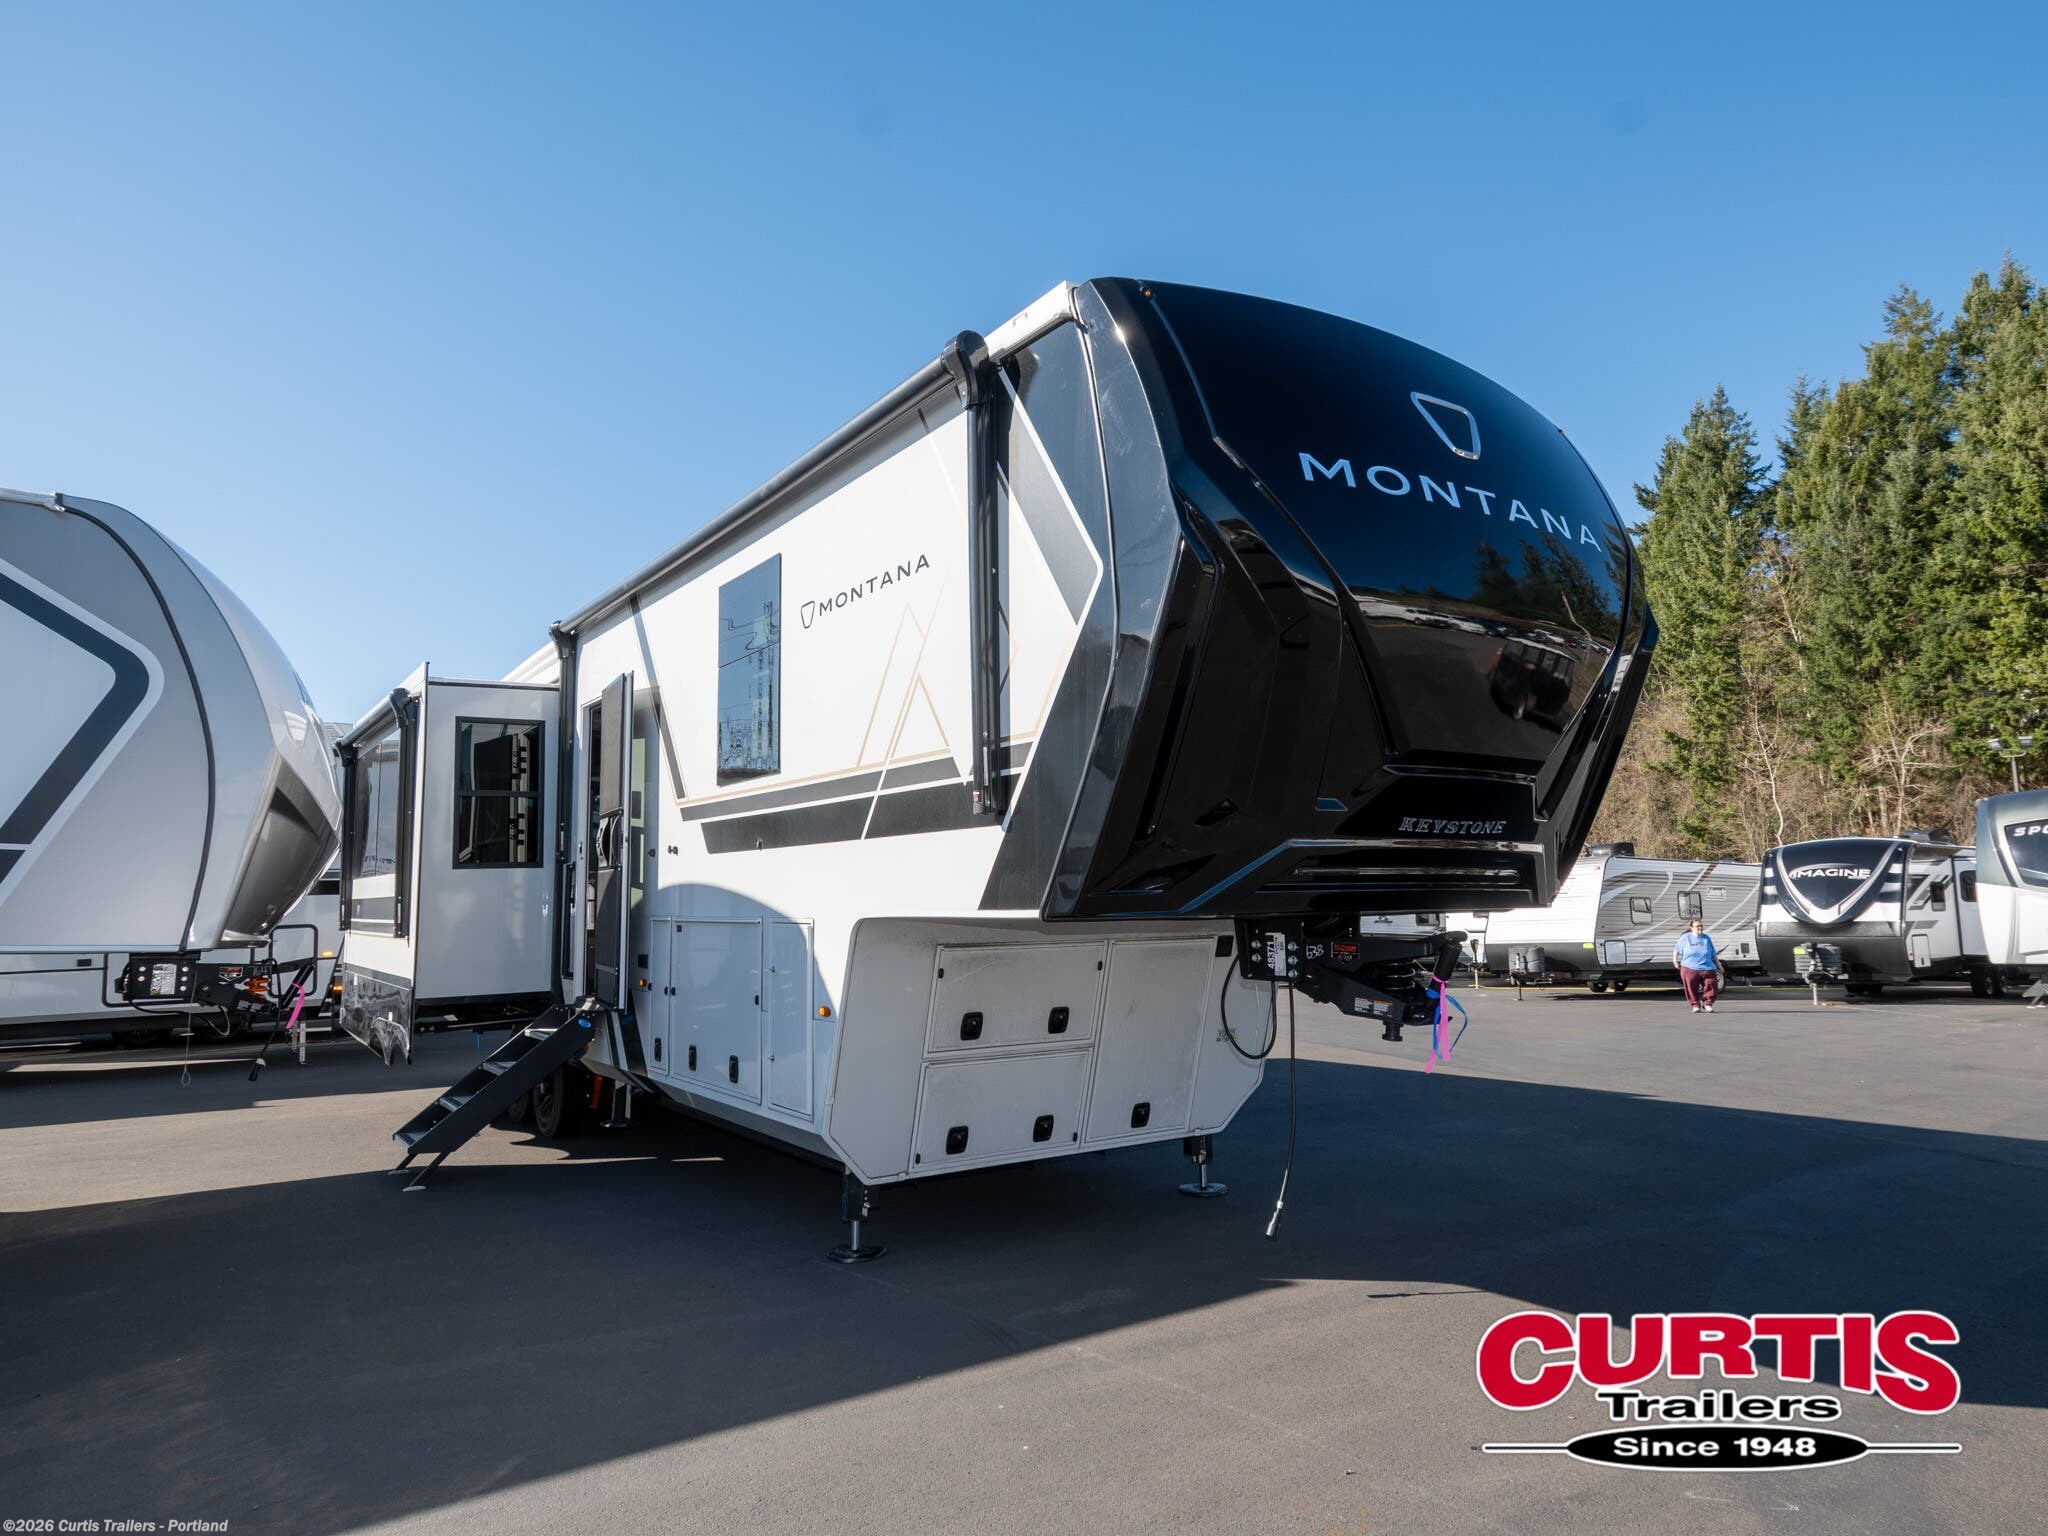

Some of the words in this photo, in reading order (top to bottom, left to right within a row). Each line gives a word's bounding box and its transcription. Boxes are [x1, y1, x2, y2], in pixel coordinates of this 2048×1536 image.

[1298, 452, 1603, 553] MONTANA
[819, 553, 931, 617] MONTANA
[1398, 816, 1507, 835] KEYSTONE
[1792, 867, 1872, 878] IMAGINE
